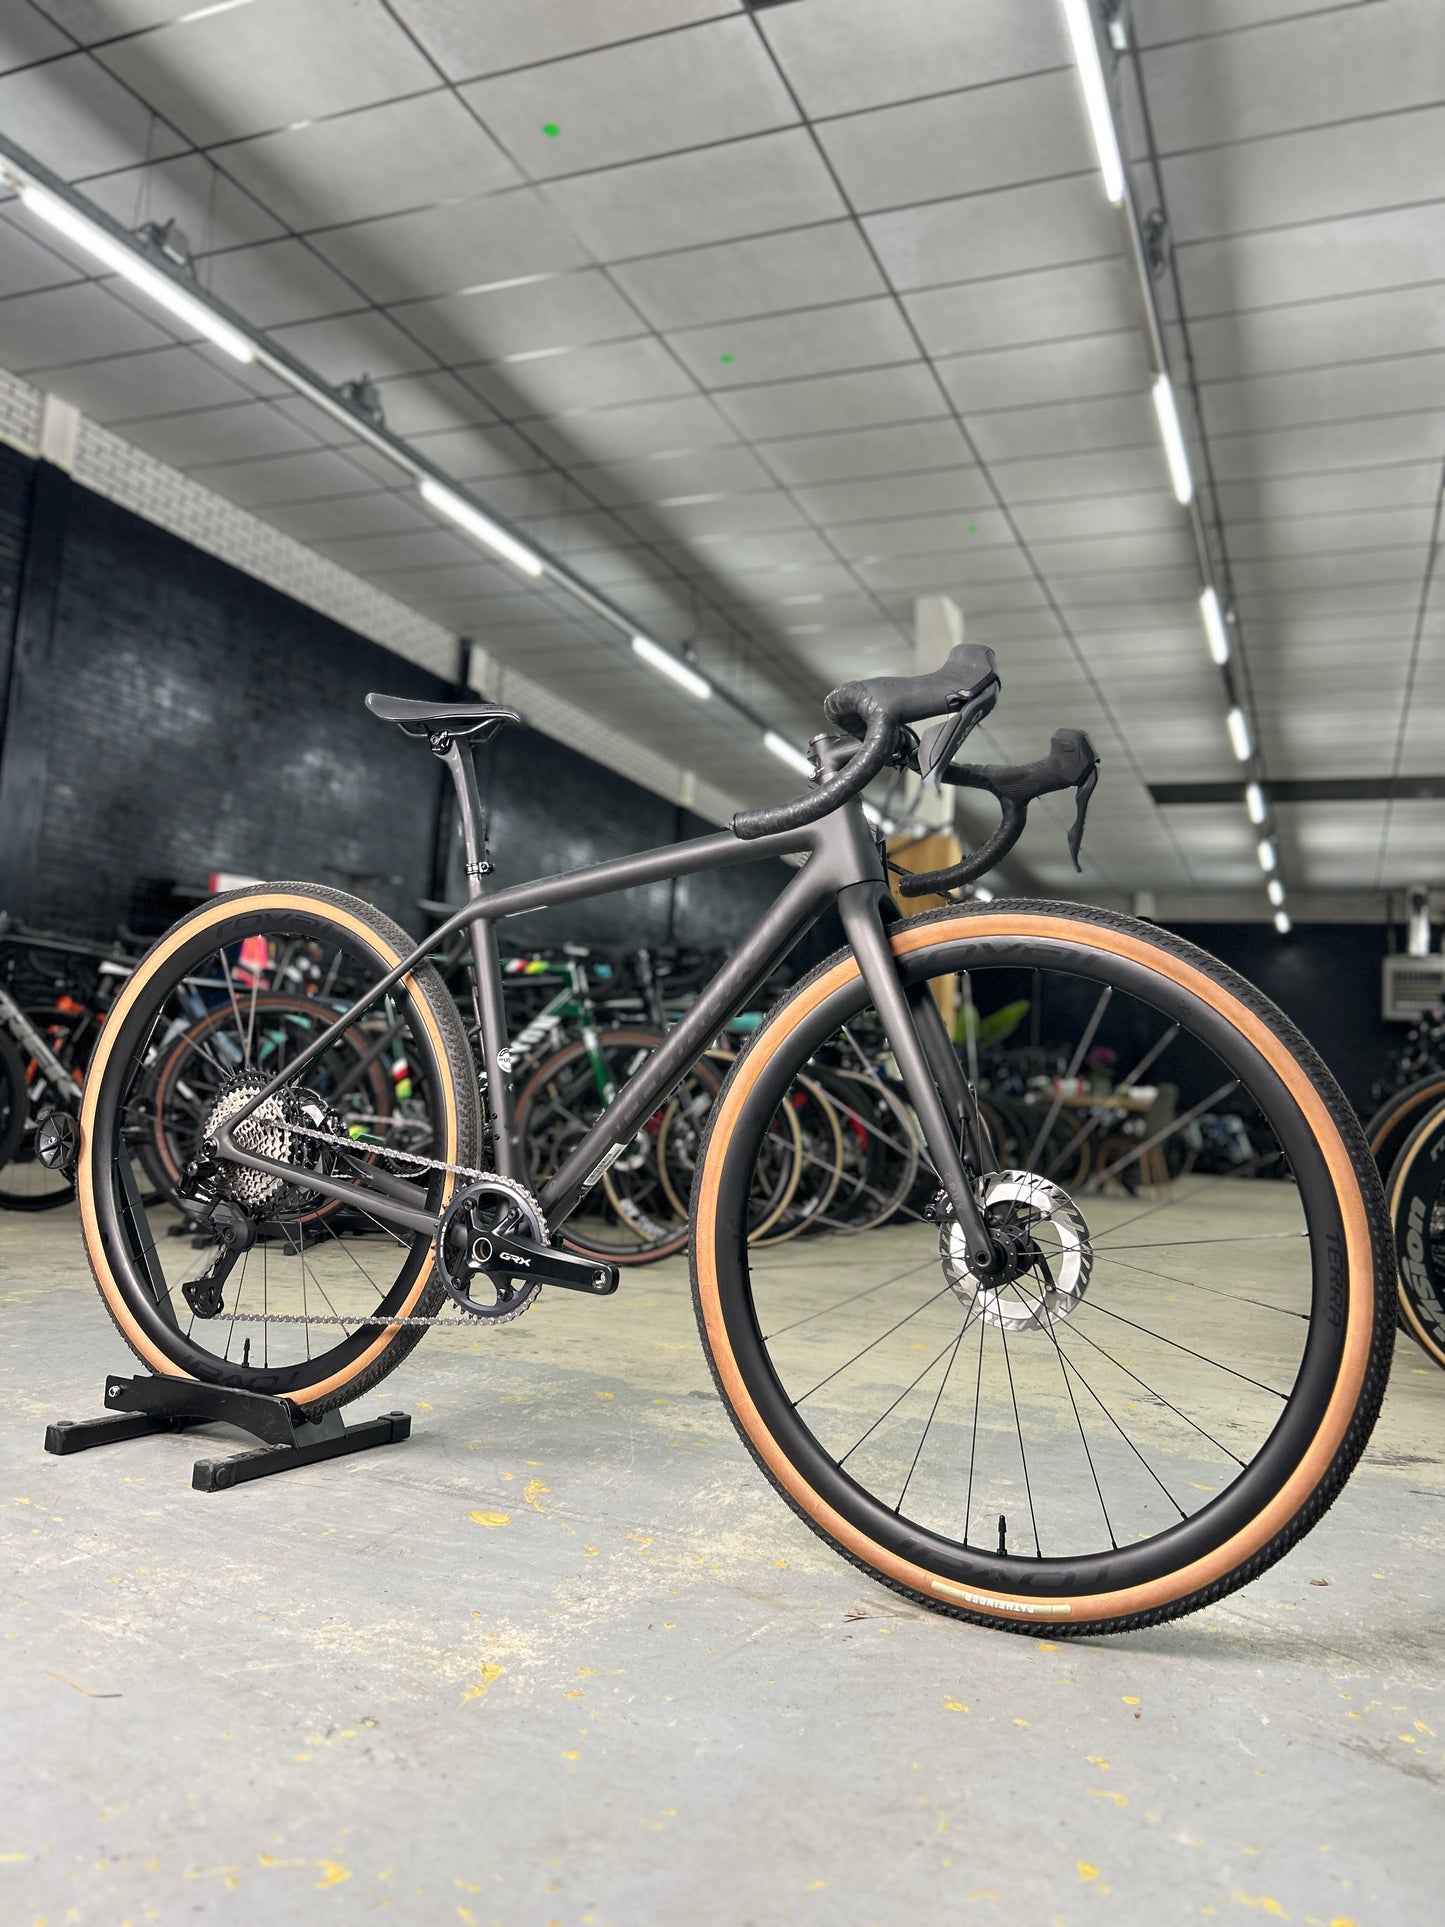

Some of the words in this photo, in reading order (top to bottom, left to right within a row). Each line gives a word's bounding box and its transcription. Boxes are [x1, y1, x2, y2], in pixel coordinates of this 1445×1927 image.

[499, 1251, 532, 1267] GRX
[1326, 1232, 1345, 1328] TERRA
[964, 1593, 1035, 1613] PATHFINDER
